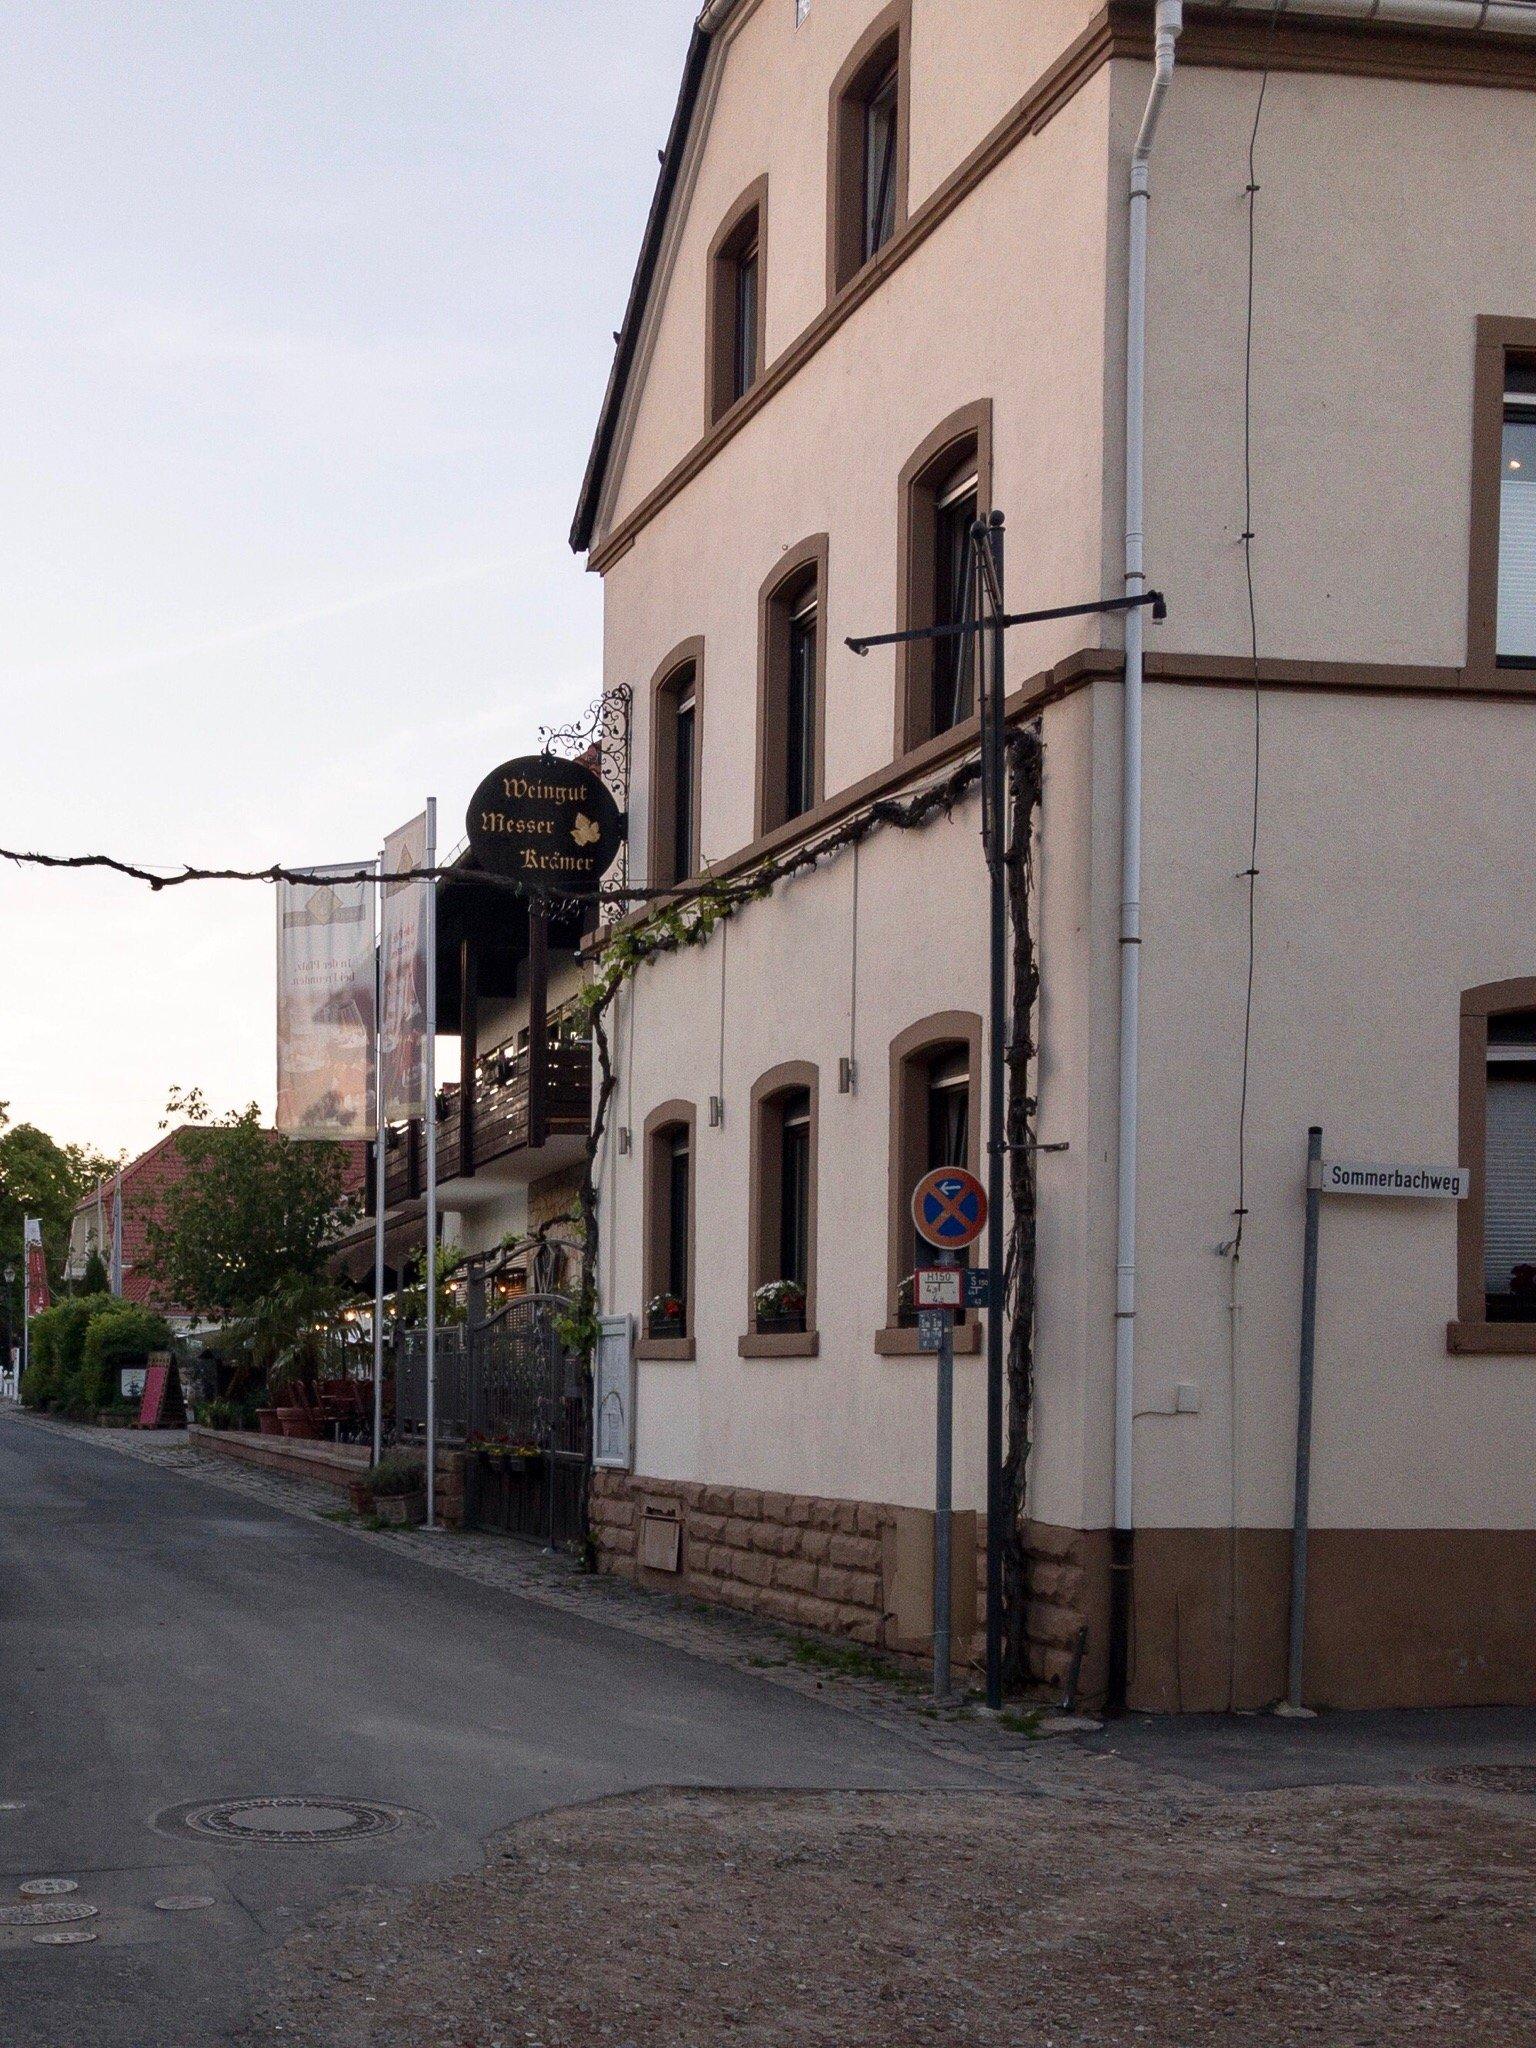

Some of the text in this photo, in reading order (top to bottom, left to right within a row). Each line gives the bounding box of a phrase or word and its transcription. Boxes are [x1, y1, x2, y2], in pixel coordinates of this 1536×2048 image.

[503, 778, 589, 805] Weingut
[481, 812, 555, 834] Messer
[520, 848, 594, 871] Krämer
[1332, 1166, 1460, 1195] Sommerbachweg
